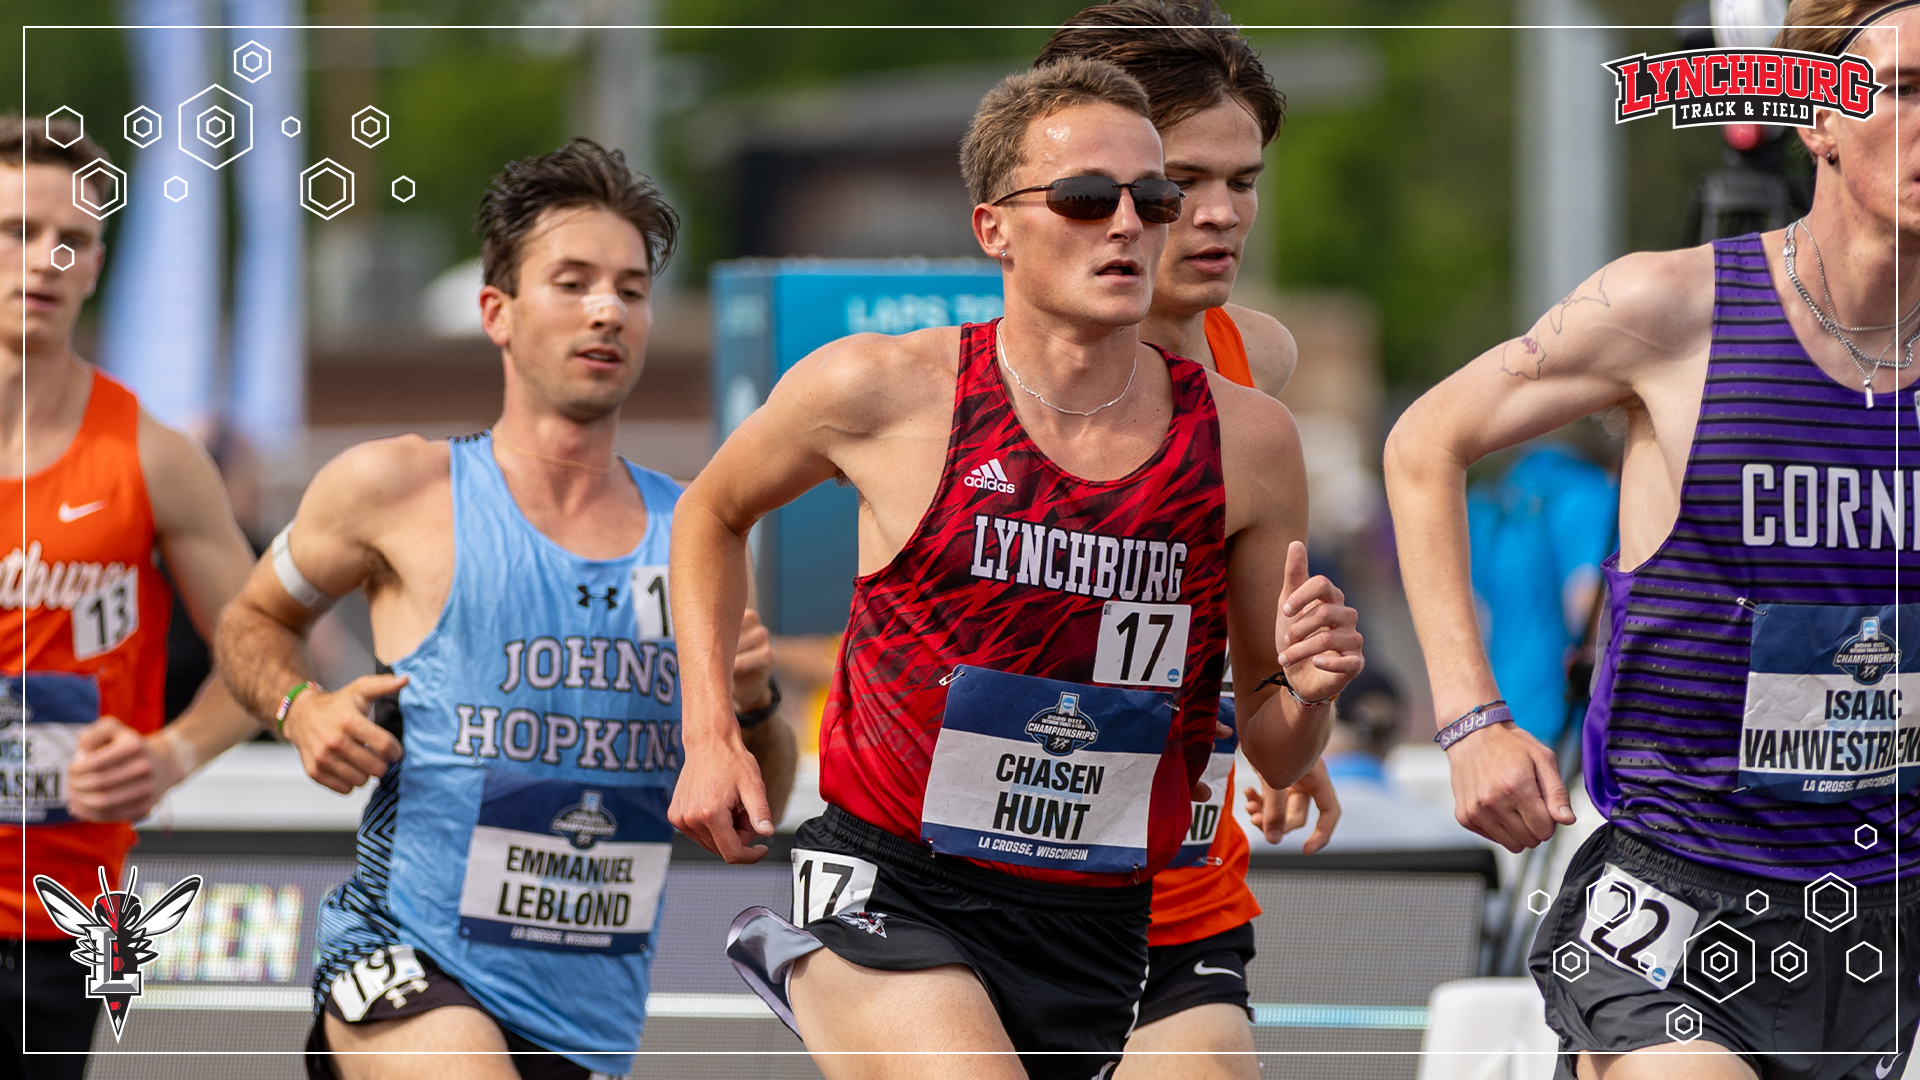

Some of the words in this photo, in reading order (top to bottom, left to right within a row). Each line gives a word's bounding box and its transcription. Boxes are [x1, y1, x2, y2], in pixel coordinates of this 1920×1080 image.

[964, 475, 1016, 494] adidas
[1742, 463, 1920, 550] CORN
[970, 515, 1188, 602] LYNCHBURG
[89, 586, 128, 647] 13
[1116, 611, 1174, 682] 17
[499, 636, 678, 706] JOHNS
[1824, 689, 1903, 721] ISAAC
[1027, 722, 1097, 741] CHAMPIONSHIPS
[1745, 727, 1920, 771] VANWESTRIEN
[996, 753, 1105, 795] CHASEN
[992, 791, 1091, 841] HUNT
[506, 846, 635, 884] EMMANUEL
[978, 836, 991, 849] LA
[992, 839, 1034, 857] CROSSE,
[1036, 845, 1089, 861] WISCONSIN
[497, 882, 632, 928] LEBLOND
[799, 859, 855, 928] 17
[1590, 880, 1671, 976] 22
